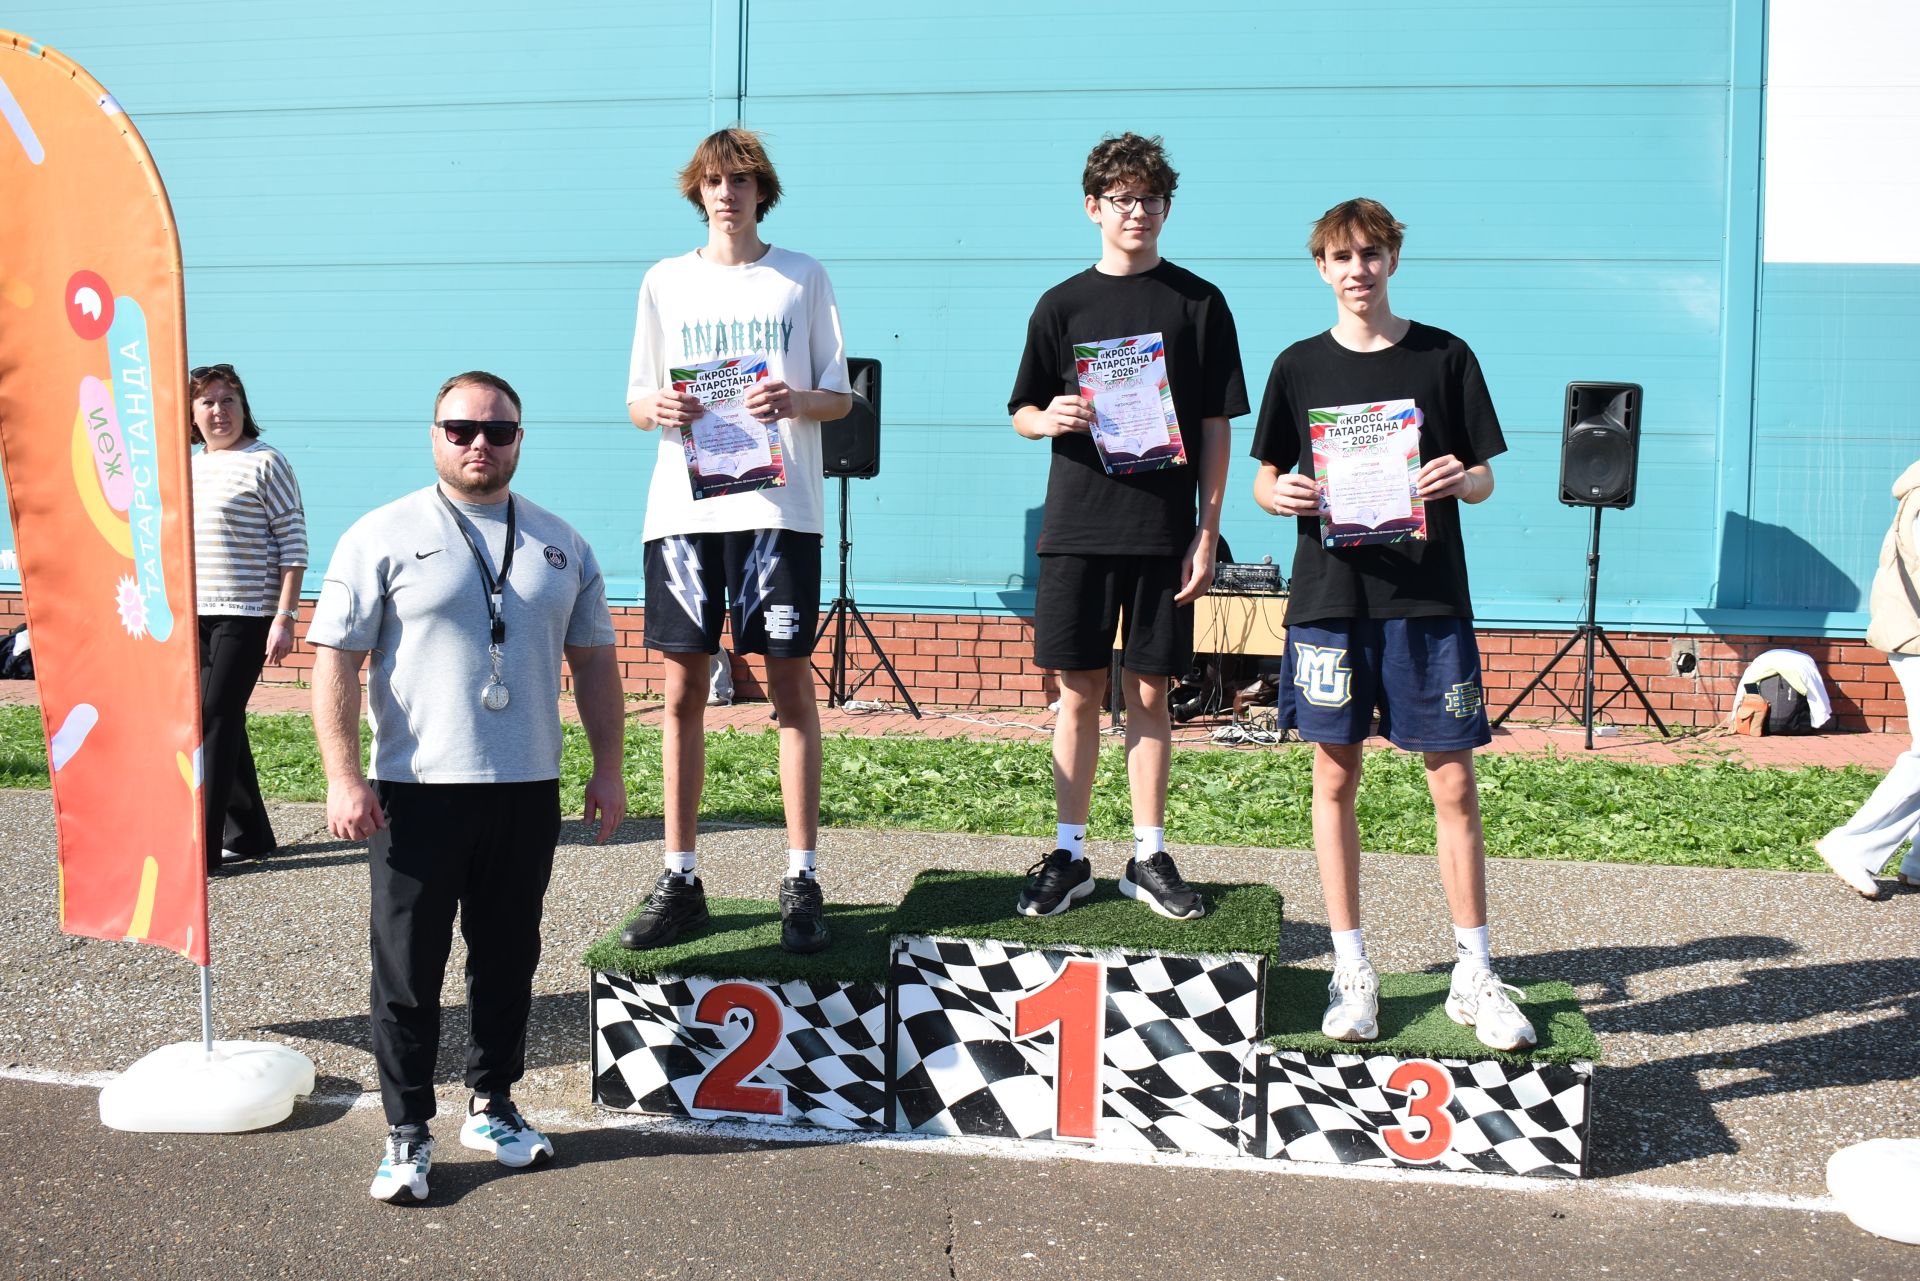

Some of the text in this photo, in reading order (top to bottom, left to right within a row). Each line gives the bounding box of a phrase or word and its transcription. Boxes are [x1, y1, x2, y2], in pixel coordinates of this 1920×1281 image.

[681, 314, 794, 360] ANARCHY
[1100, 346, 1137, 359] «КРОСС
[1090, 354, 1150, 372] ТАТАРСТАНА
[699, 367, 739, 382] «КРОСС
[1111, 367, 1139, 379] 2026»
[688, 374, 754, 394] ТАТАРСТАНА
[711, 387, 742, 400] 2026»
[1340, 412, 1384, 425] «КРОСС
[1328, 421, 1399, 437] ТАТАРСТАНА
[1351, 434, 1385, 446] 2026»
[119, 339, 161, 600] ТАТАРСТАНДА
[1294, 642, 1352, 708] MU
[692, 982, 784, 1116] 2
[1014, 960, 1103, 1139] 1
[1382, 1061, 1451, 1161] 3
